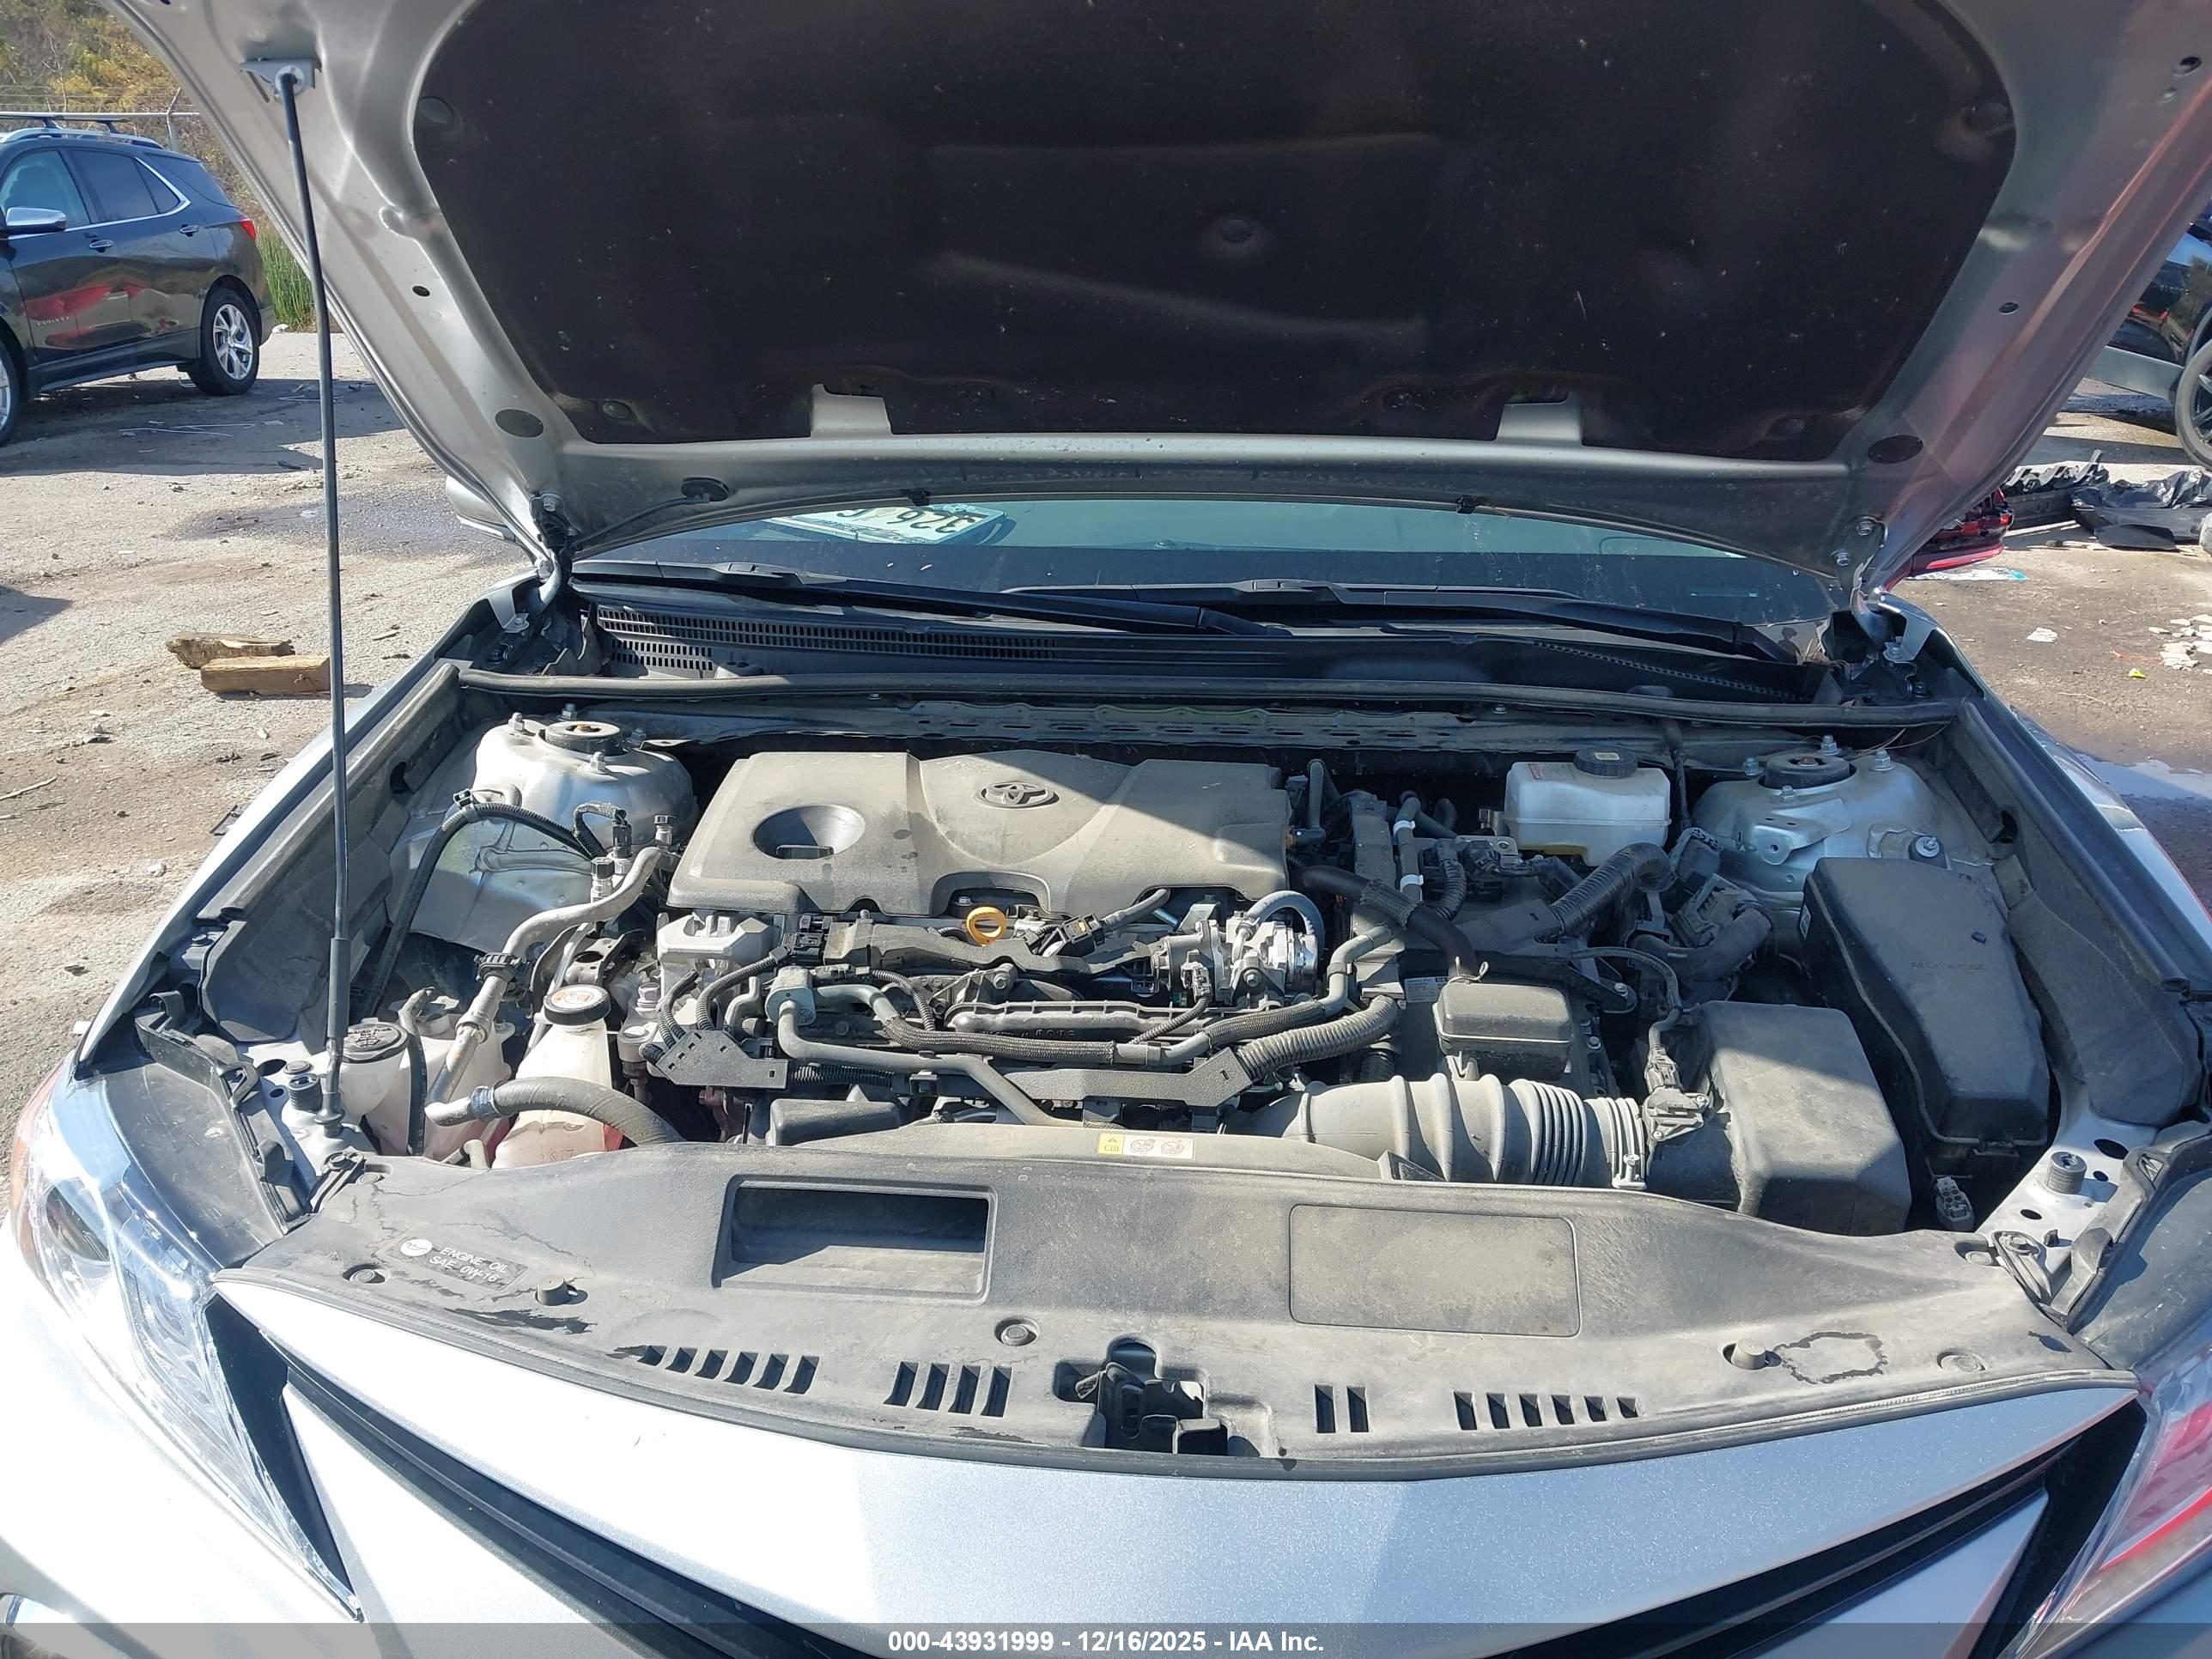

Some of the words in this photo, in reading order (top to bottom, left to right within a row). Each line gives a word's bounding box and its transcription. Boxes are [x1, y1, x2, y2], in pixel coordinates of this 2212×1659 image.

[429, 1255, 457, 1269] SAE
[440, 1247, 488, 1266] ENGINE
[489, 1261, 509, 1273] OIL
